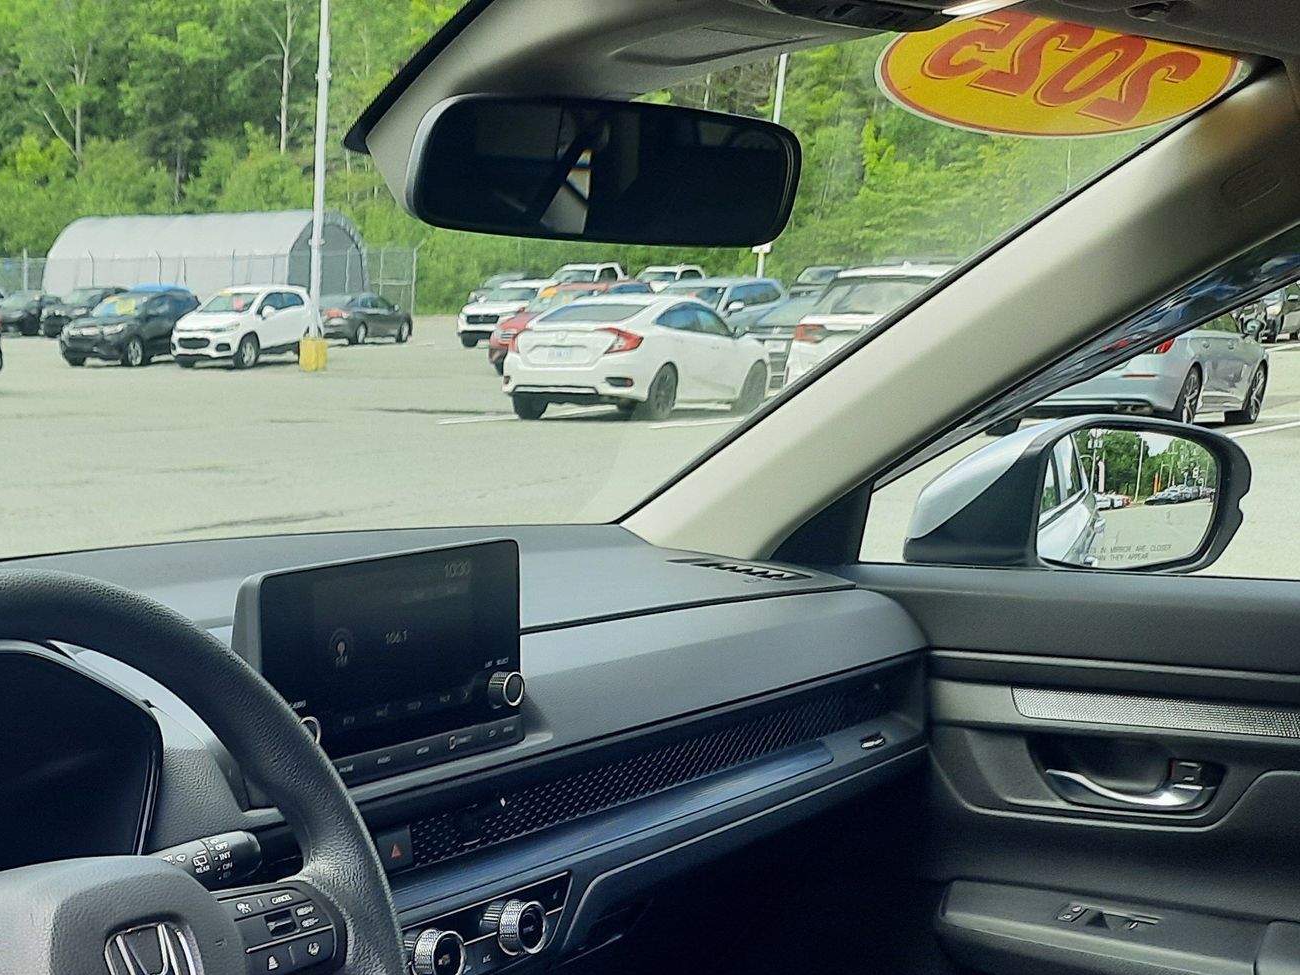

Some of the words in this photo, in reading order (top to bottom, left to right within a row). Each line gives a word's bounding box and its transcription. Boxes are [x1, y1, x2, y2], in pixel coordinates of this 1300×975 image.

[215, 842, 228, 851] OFF
[219, 851, 231, 861] INT
[195, 865, 210, 874] REAR
[222, 862, 233, 870] ON
[271, 894, 293, 904] CANCEL
